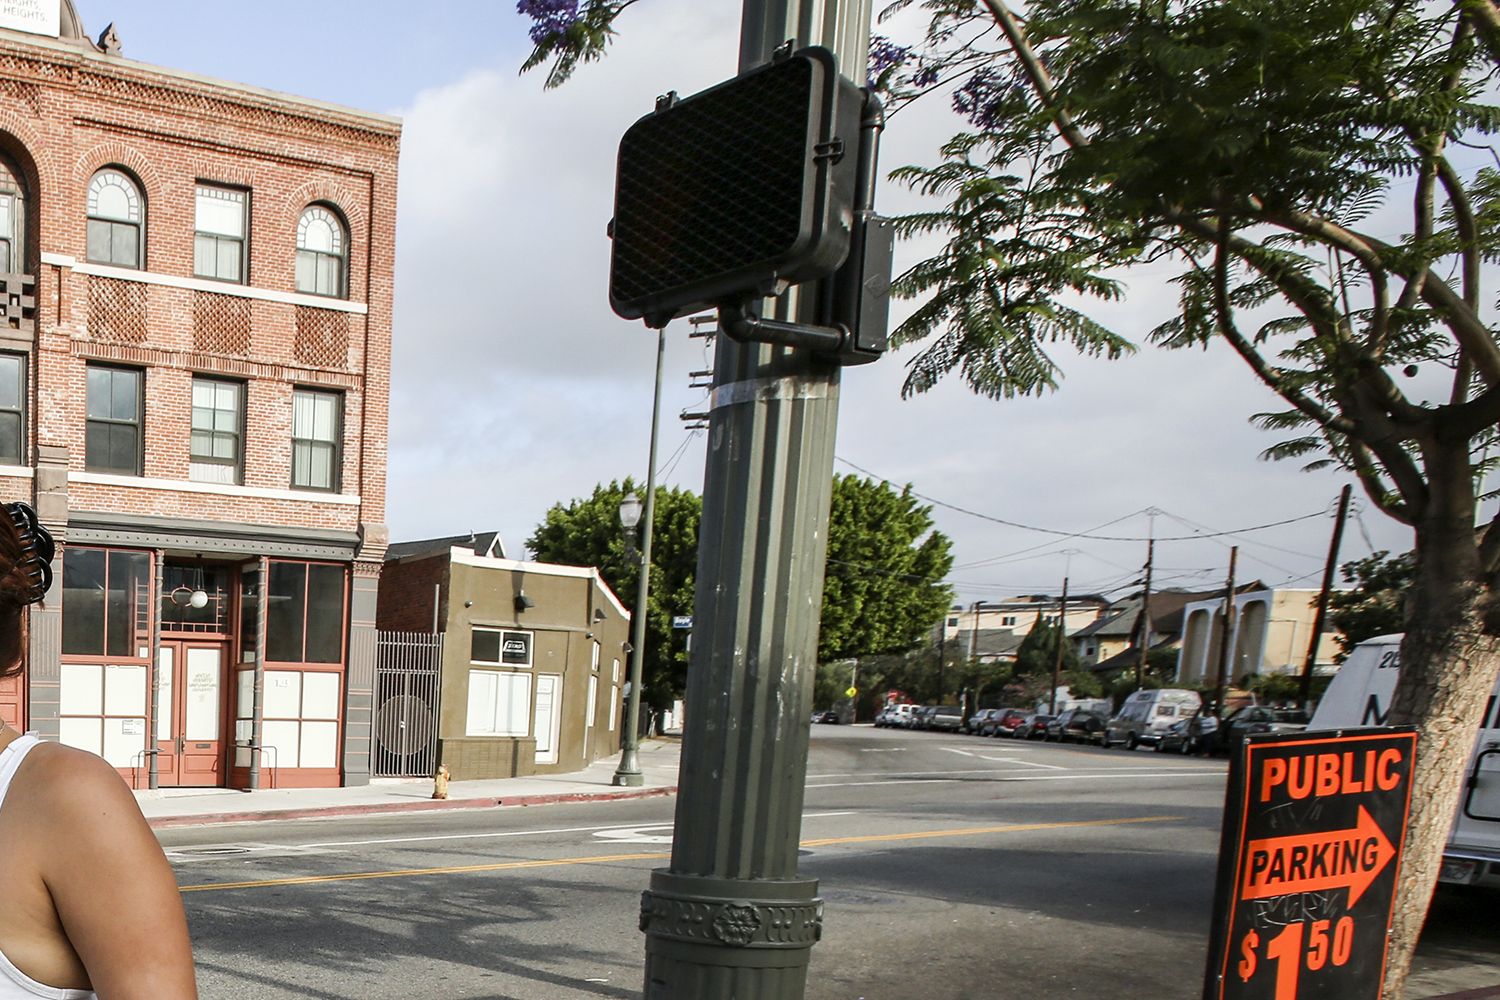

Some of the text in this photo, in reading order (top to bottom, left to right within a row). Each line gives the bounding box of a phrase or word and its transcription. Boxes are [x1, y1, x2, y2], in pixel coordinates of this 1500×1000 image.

[3, 5, 49, 22] HEIGHTS.
[1260, 748, 1402, 802] PUBLIC
[1249, 836, 1379, 887] PARKING
